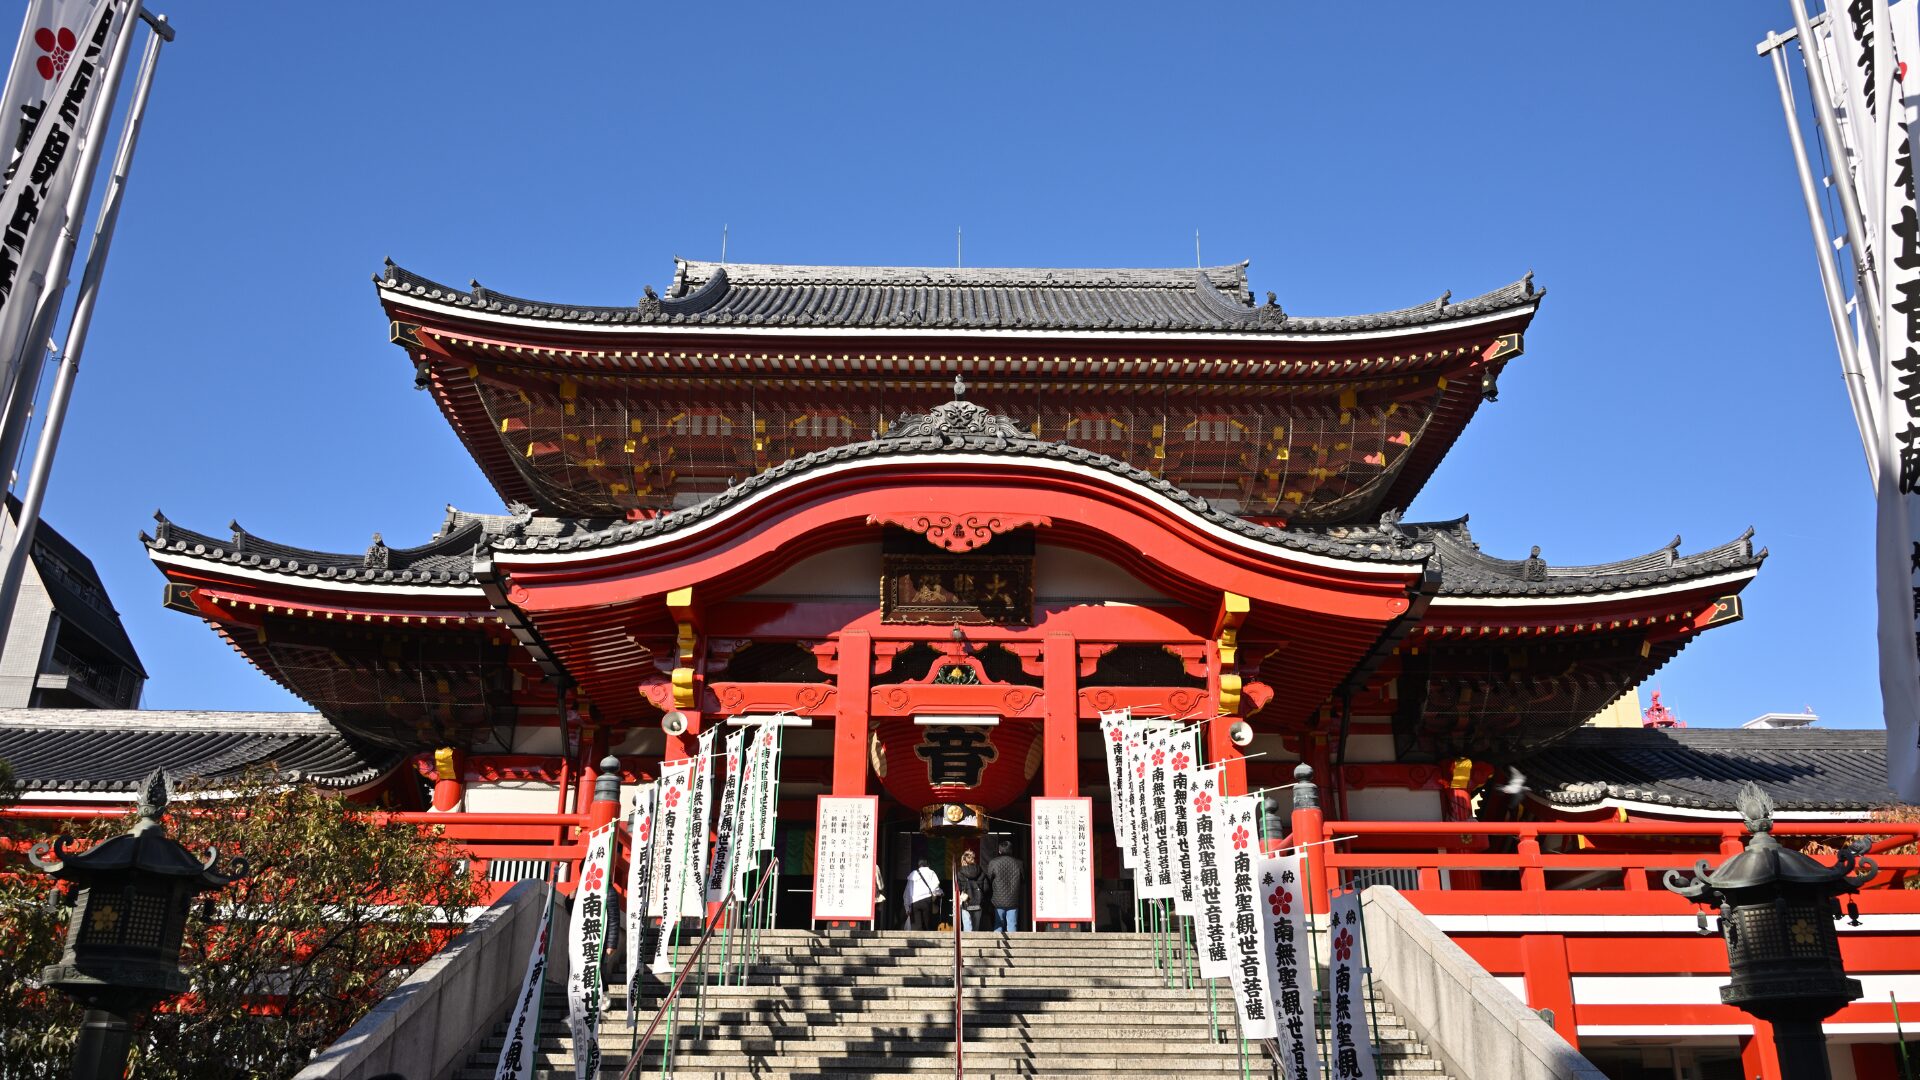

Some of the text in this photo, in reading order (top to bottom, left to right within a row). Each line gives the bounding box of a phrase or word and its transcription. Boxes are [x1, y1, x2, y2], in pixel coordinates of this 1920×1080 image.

[1190, 779, 1214, 792] 奉納
[1228, 811, 1251, 826] 奉納
[1196, 813, 1228, 962] 南無聖観世音菩薩
[1262, 870, 1295, 887] 奉納
[1331, 909, 1357, 929] 奉納
[1234, 851, 1266, 1021] 南無聖観世音菩薩
[1336, 963, 1363, 1080] 南無聖観
